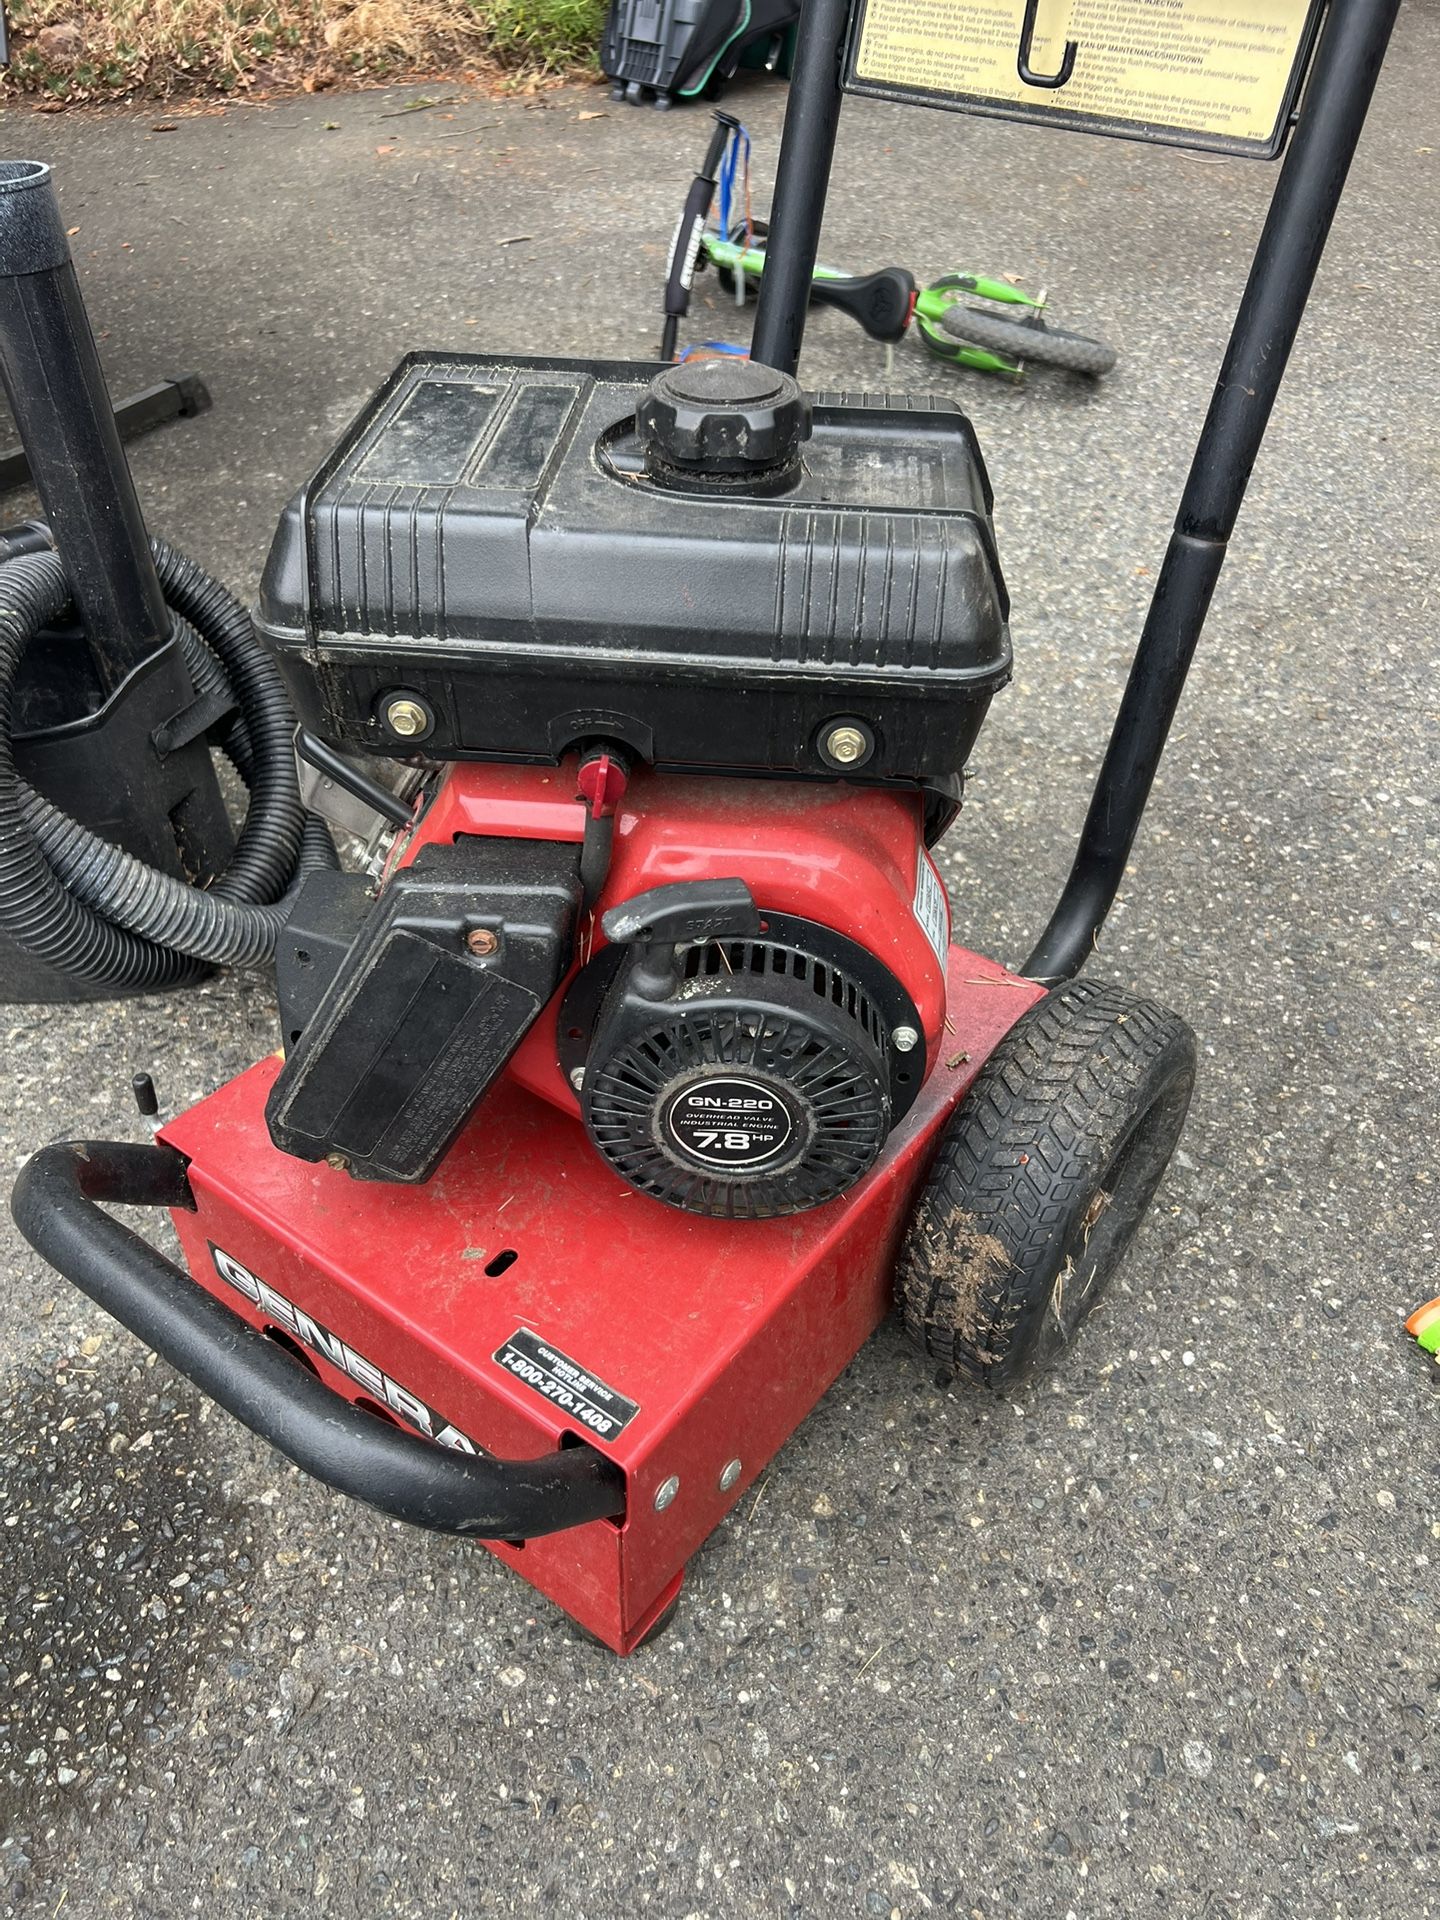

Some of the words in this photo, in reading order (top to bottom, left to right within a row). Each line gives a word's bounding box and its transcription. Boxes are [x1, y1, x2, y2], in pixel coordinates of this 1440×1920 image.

[896, 7, 915, 15] engine
[916, 9, 935, 17] throttle
[957, 4, 978, 13] starting
[922, 20, 938, 28] prime
[939, 22, 958, 31] engine
[1127, 17, 1155, 28] pressure
[1139, 7, 1165, 17] injection
[1166, 11, 1180, 19] tube
[1236, 20, 1264, 32] cleaning
[896, 26, 912, 34] adjust
[963, 35, 985, 45] position
[996, 40, 1013, 48] choke
[1081, 21, 1095, 29] stop
[1096, 22, 1123, 32] chemical
[1124, 25, 1159, 38] application
[1171, 32, 1192, 41] nozzle
[1201, 36, 1217, 46] high
[1217, 39, 1247, 51] pressure
[1248, 43, 1275, 54] position
[1132, 38, 1158, 48] cleaning
[888, 53, 906, 62] trigger
[934, 60, 953, 68] release
[944, 52, 960, 60] prime
[1108, 44, 1203, 65] MAINTENANCE/SHUTDOWN
[870, 60, 887, 69] Grasp
[888, 64, 906, 72] engine
[923, 68, 941, 76] handle
[1084, 51, 1100, 59] clean
[1102, 54, 1118, 62] water
[1128, 58, 1143, 66] flush
[1144, 60, 1169, 71] through
[1170, 64, 1188, 74] pump
[1203, 69, 1232, 79] chemical
[1233, 73, 1259, 84] injector
[953, 82, 971, 91] repeat
[994, 88, 1016, 99] through
[1083, 82, 1103, 91] trigger
[1145, 92, 1169, 101] release
[1182, 98, 1210, 108] pressure
[1057, 89, 1082, 97] Remove
[1094, 94, 1112, 102] hoses
[1127, 99, 1143, 107] drain
[1163, 104, 1177, 112] from
[1066, 99, 1079, 107] cold
[1080, 102, 1105, 111] weather
[1131, 109, 1152, 119] please
[1154, 113, 1169, 121] read
[686, 914, 733, 931] START
[688, 1096, 773, 1110] GN-220
[680, 1120, 739, 1128] INDUSTRIAL
[742, 1122, 779, 1130] ENGINE
[686, 1113, 741, 1121] OVERHEAD
[692, 1131, 750, 1150] 7.8
[752, 1134, 774, 1142] HP
[214, 1248, 484, 1456] GENERA
[537, 1347, 581, 1379] CUSTOMER
[578, 1374, 614, 1401] SERVICE
[551, 1366, 588, 1394] HOTLINE
[501, 1352, 613, 1433] 1-800-270-1408
